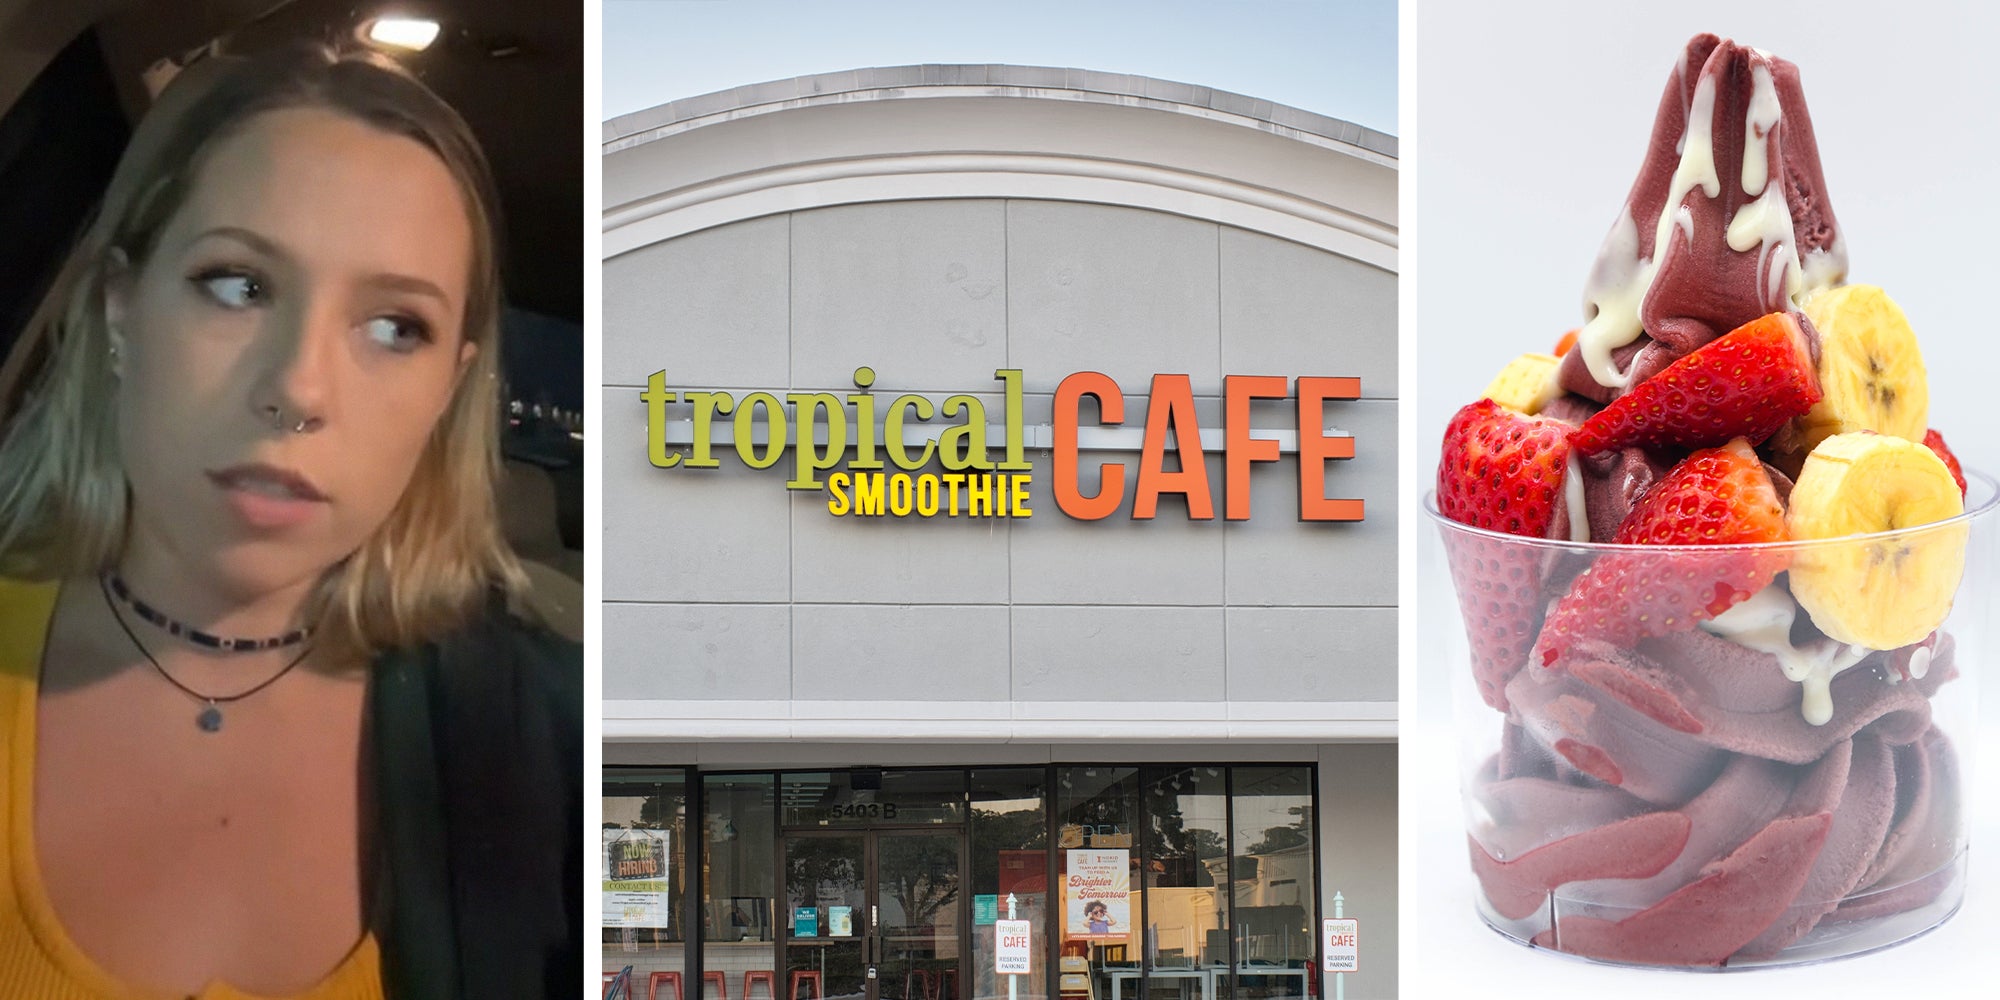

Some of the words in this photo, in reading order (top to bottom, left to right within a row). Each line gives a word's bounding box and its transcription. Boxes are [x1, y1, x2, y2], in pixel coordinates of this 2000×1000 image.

[639, 367, 1032, 491] tropical
[1052, 371, 1365, 523] CAFE
[828, 471, 1033, 519] SMOOTHIE
[831, 803, 879, 819] 5403
[883, 803, 897, 819] B
[1060, 823, 1130, 847] OPEN
[623, 842, 651, 860] NOW
[618, 858, 657, 876] HIRING
[610, 882, 647, 890] CONTACT
[1069, 875, 1112, 888] Brighter
[1078, 887, 1128, 900] Tomorrow
[999, 925, 1027, 934] tropical
[1326, 924, 1354, 933] tropical
[1003, 936, 1027, 948] CAFE
[1331, 935, 1355, 947] CAFE
